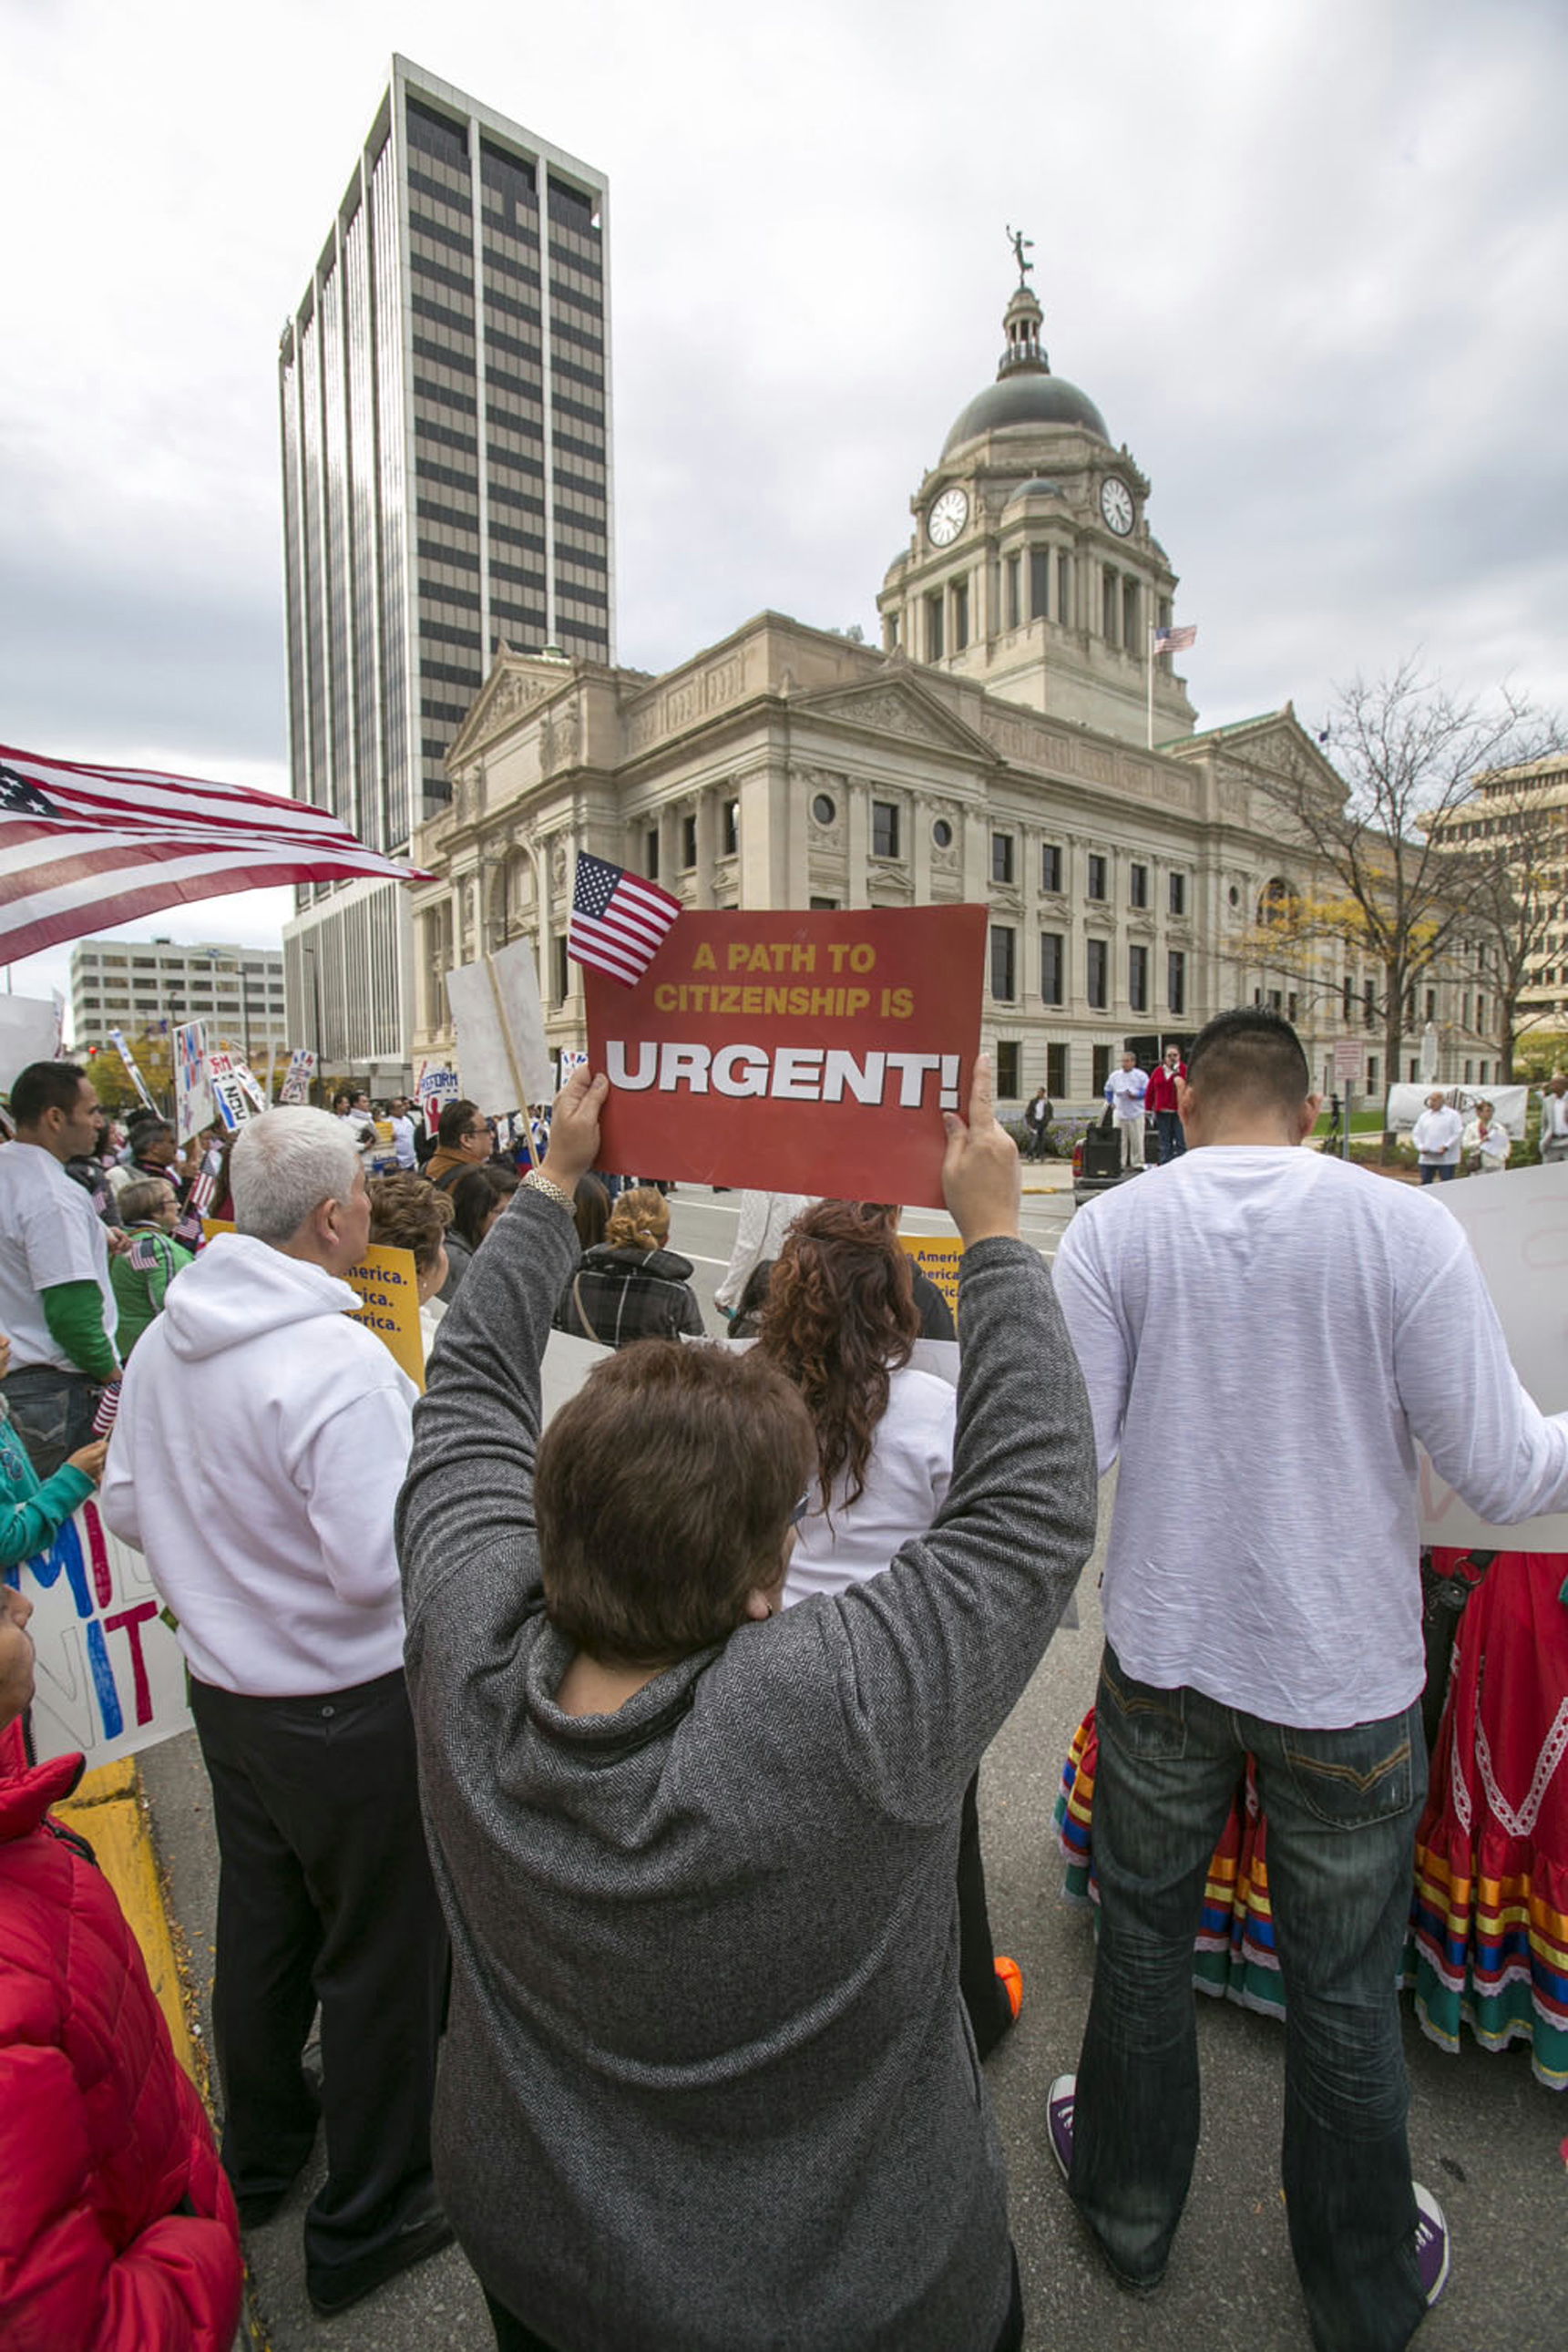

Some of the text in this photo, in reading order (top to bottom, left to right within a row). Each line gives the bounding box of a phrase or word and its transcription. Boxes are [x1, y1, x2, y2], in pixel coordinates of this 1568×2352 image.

[692, 943, 876, 973] A PATH TO
[654, 985, 915, 1019] CITIZENSHIP IS
[606, 1040, 961, 1110] URGENT!
[343, 1264, 408, 1287] merica.
